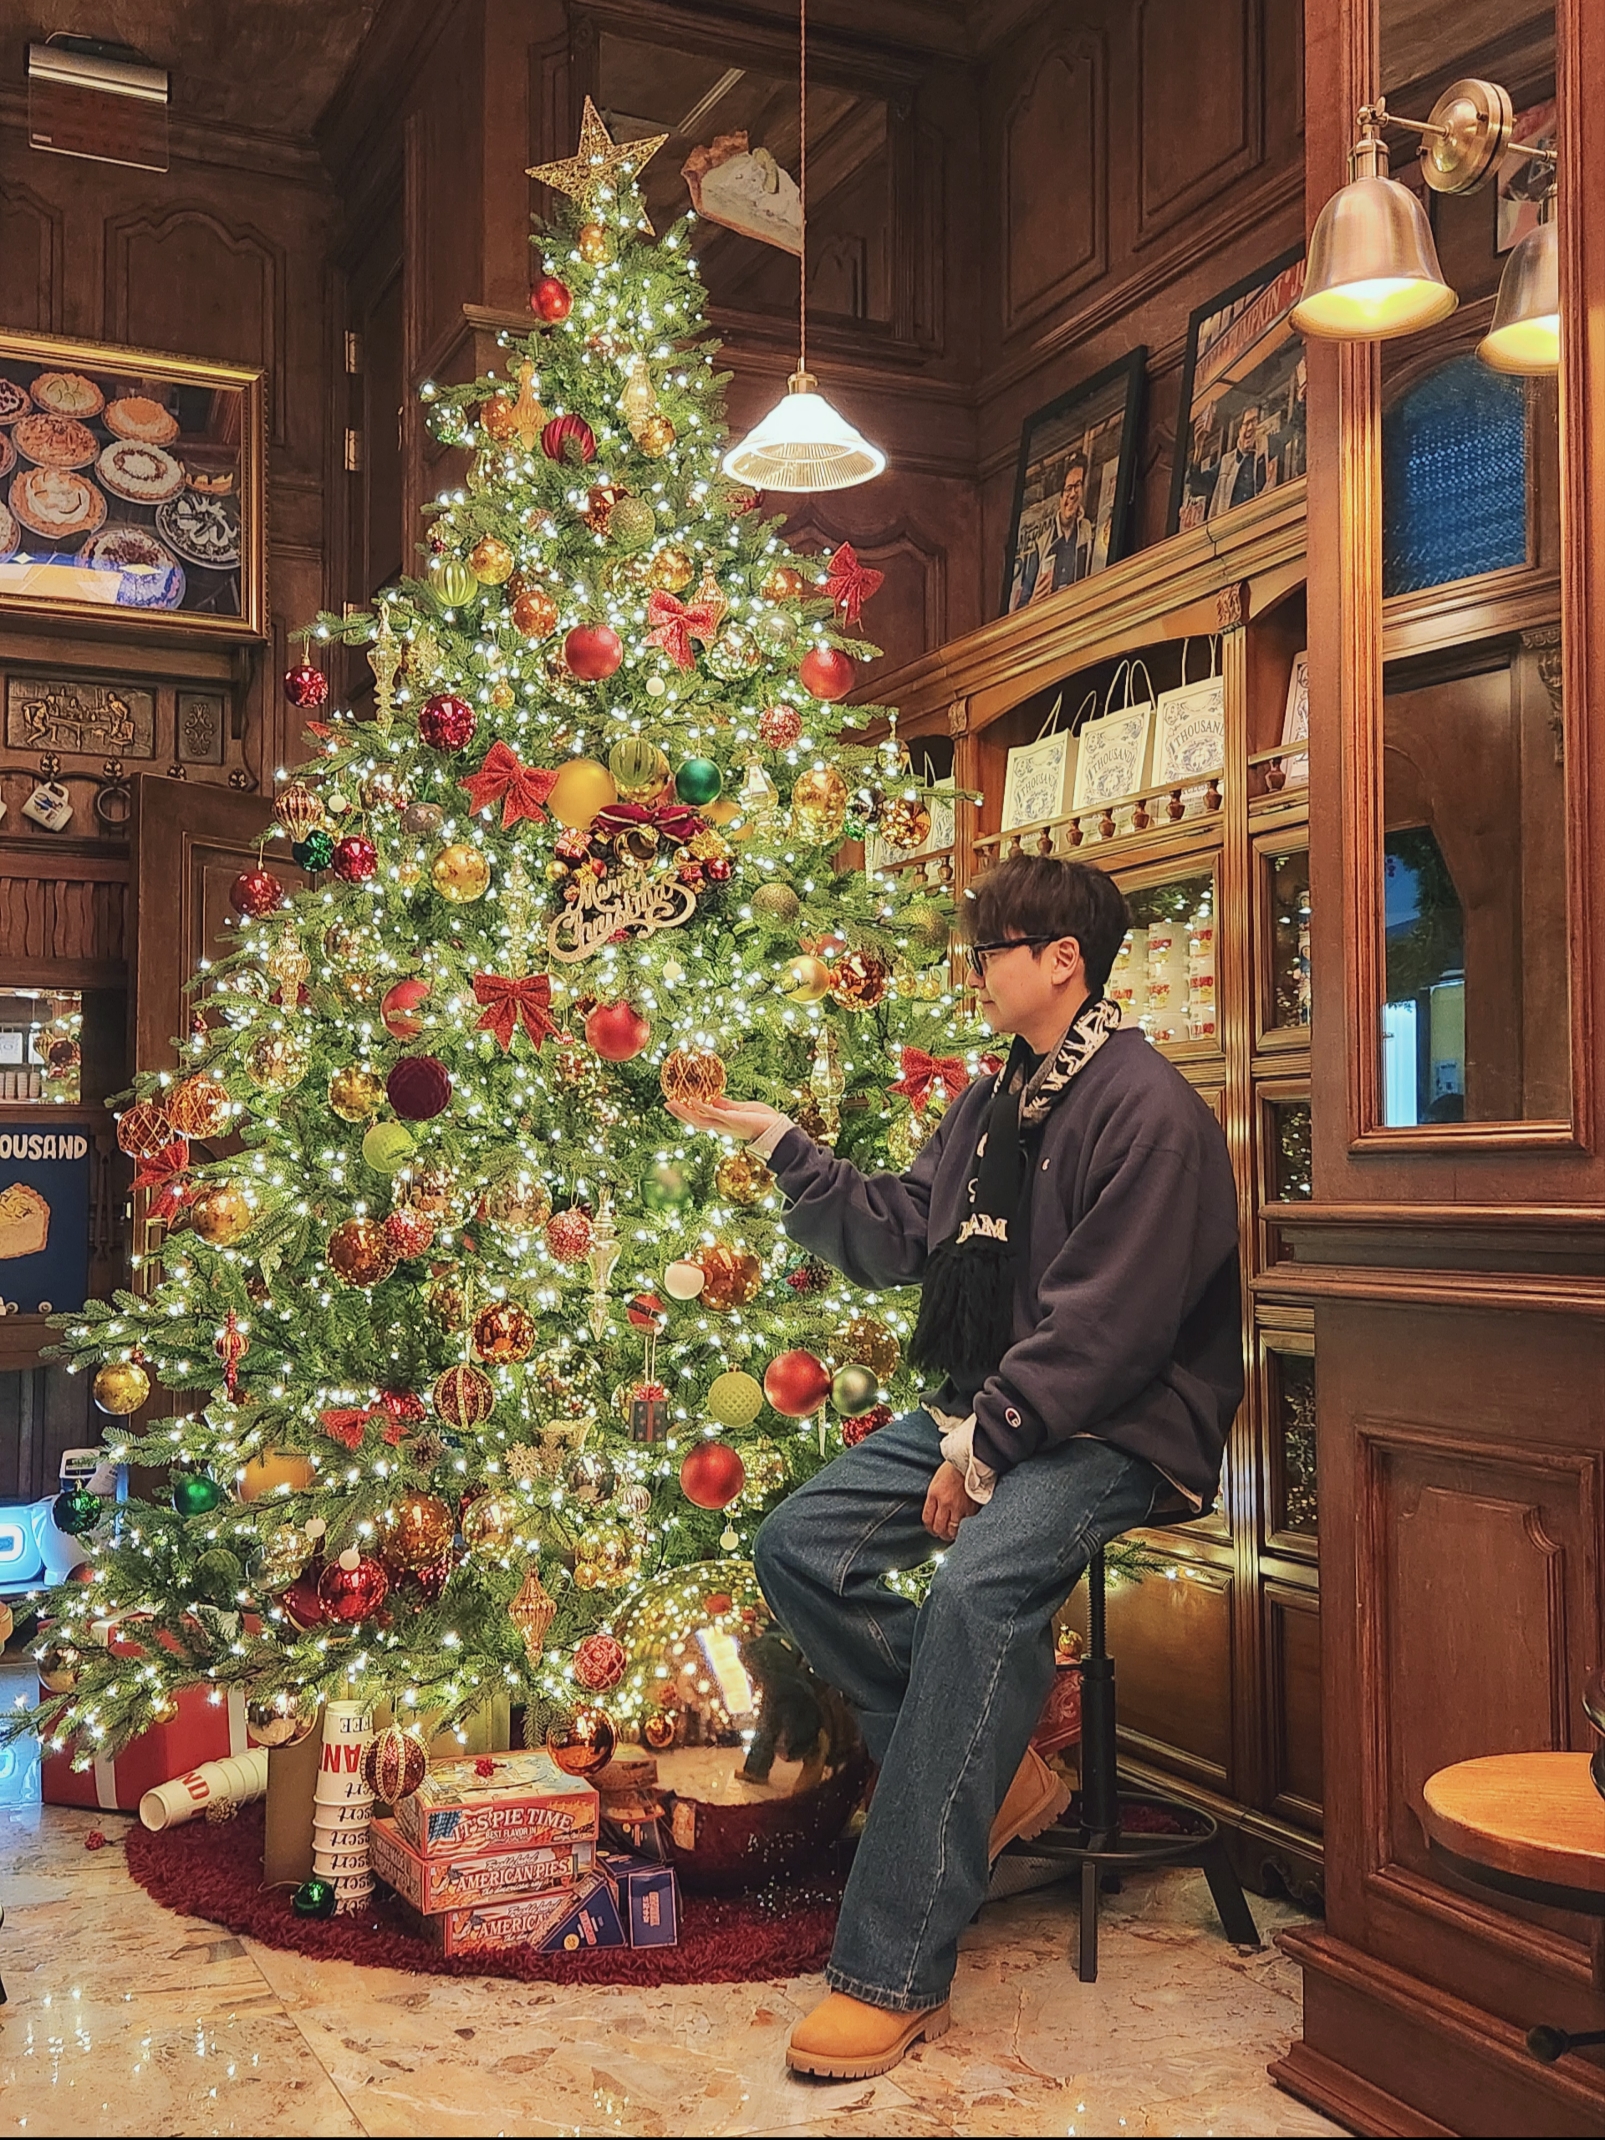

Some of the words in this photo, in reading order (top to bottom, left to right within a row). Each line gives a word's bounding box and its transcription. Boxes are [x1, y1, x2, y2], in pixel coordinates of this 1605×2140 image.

[565, 865, 648, 913] Merry
[547, 871, 696, 963] Christmas
[452, 1813, 490, 1843] IT'S
[490, 1807, 525, 1829] PIE
[526, 1807, 575, 1832] TIME
[456, 1865, 537, 1893] AMERICAN
[535, 1859, 569, 1880] PIES
